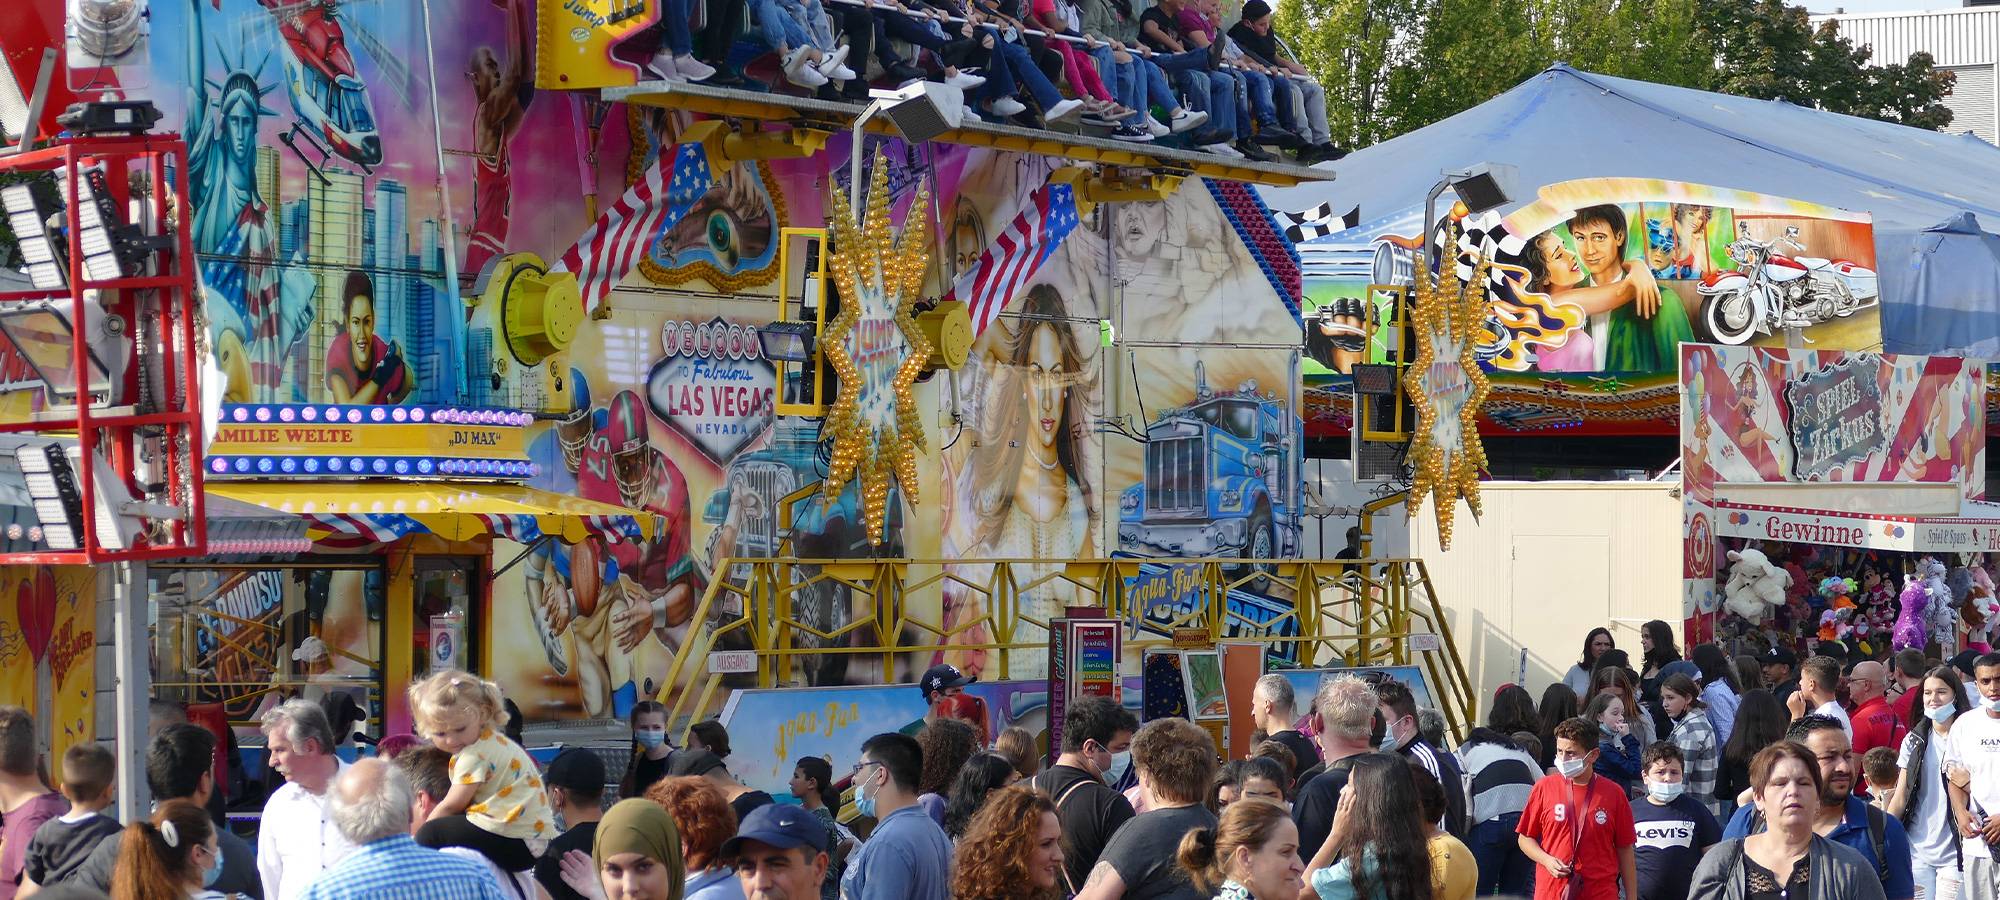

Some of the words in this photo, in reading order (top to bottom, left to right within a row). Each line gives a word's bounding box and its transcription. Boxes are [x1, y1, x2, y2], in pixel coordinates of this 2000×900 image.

[664, 327, 758, 355] WELCOM
[677, 366, 689, 378] TO
[692, 360, 754, 384] Fabulous
[668, 385, 705, 416] LAS
[711, 386, 774, 417] VEGAS
[213, 429, 279, 443] AMILIE
[284, 429, 353, 443] WELTE
[695, 423, 748, 435] NEVADA
[1765, 517, 1864, 545] Gewinne
[716, 652, 749, 671] AUSGANG
[1554, 803, 1566, 822] 9
